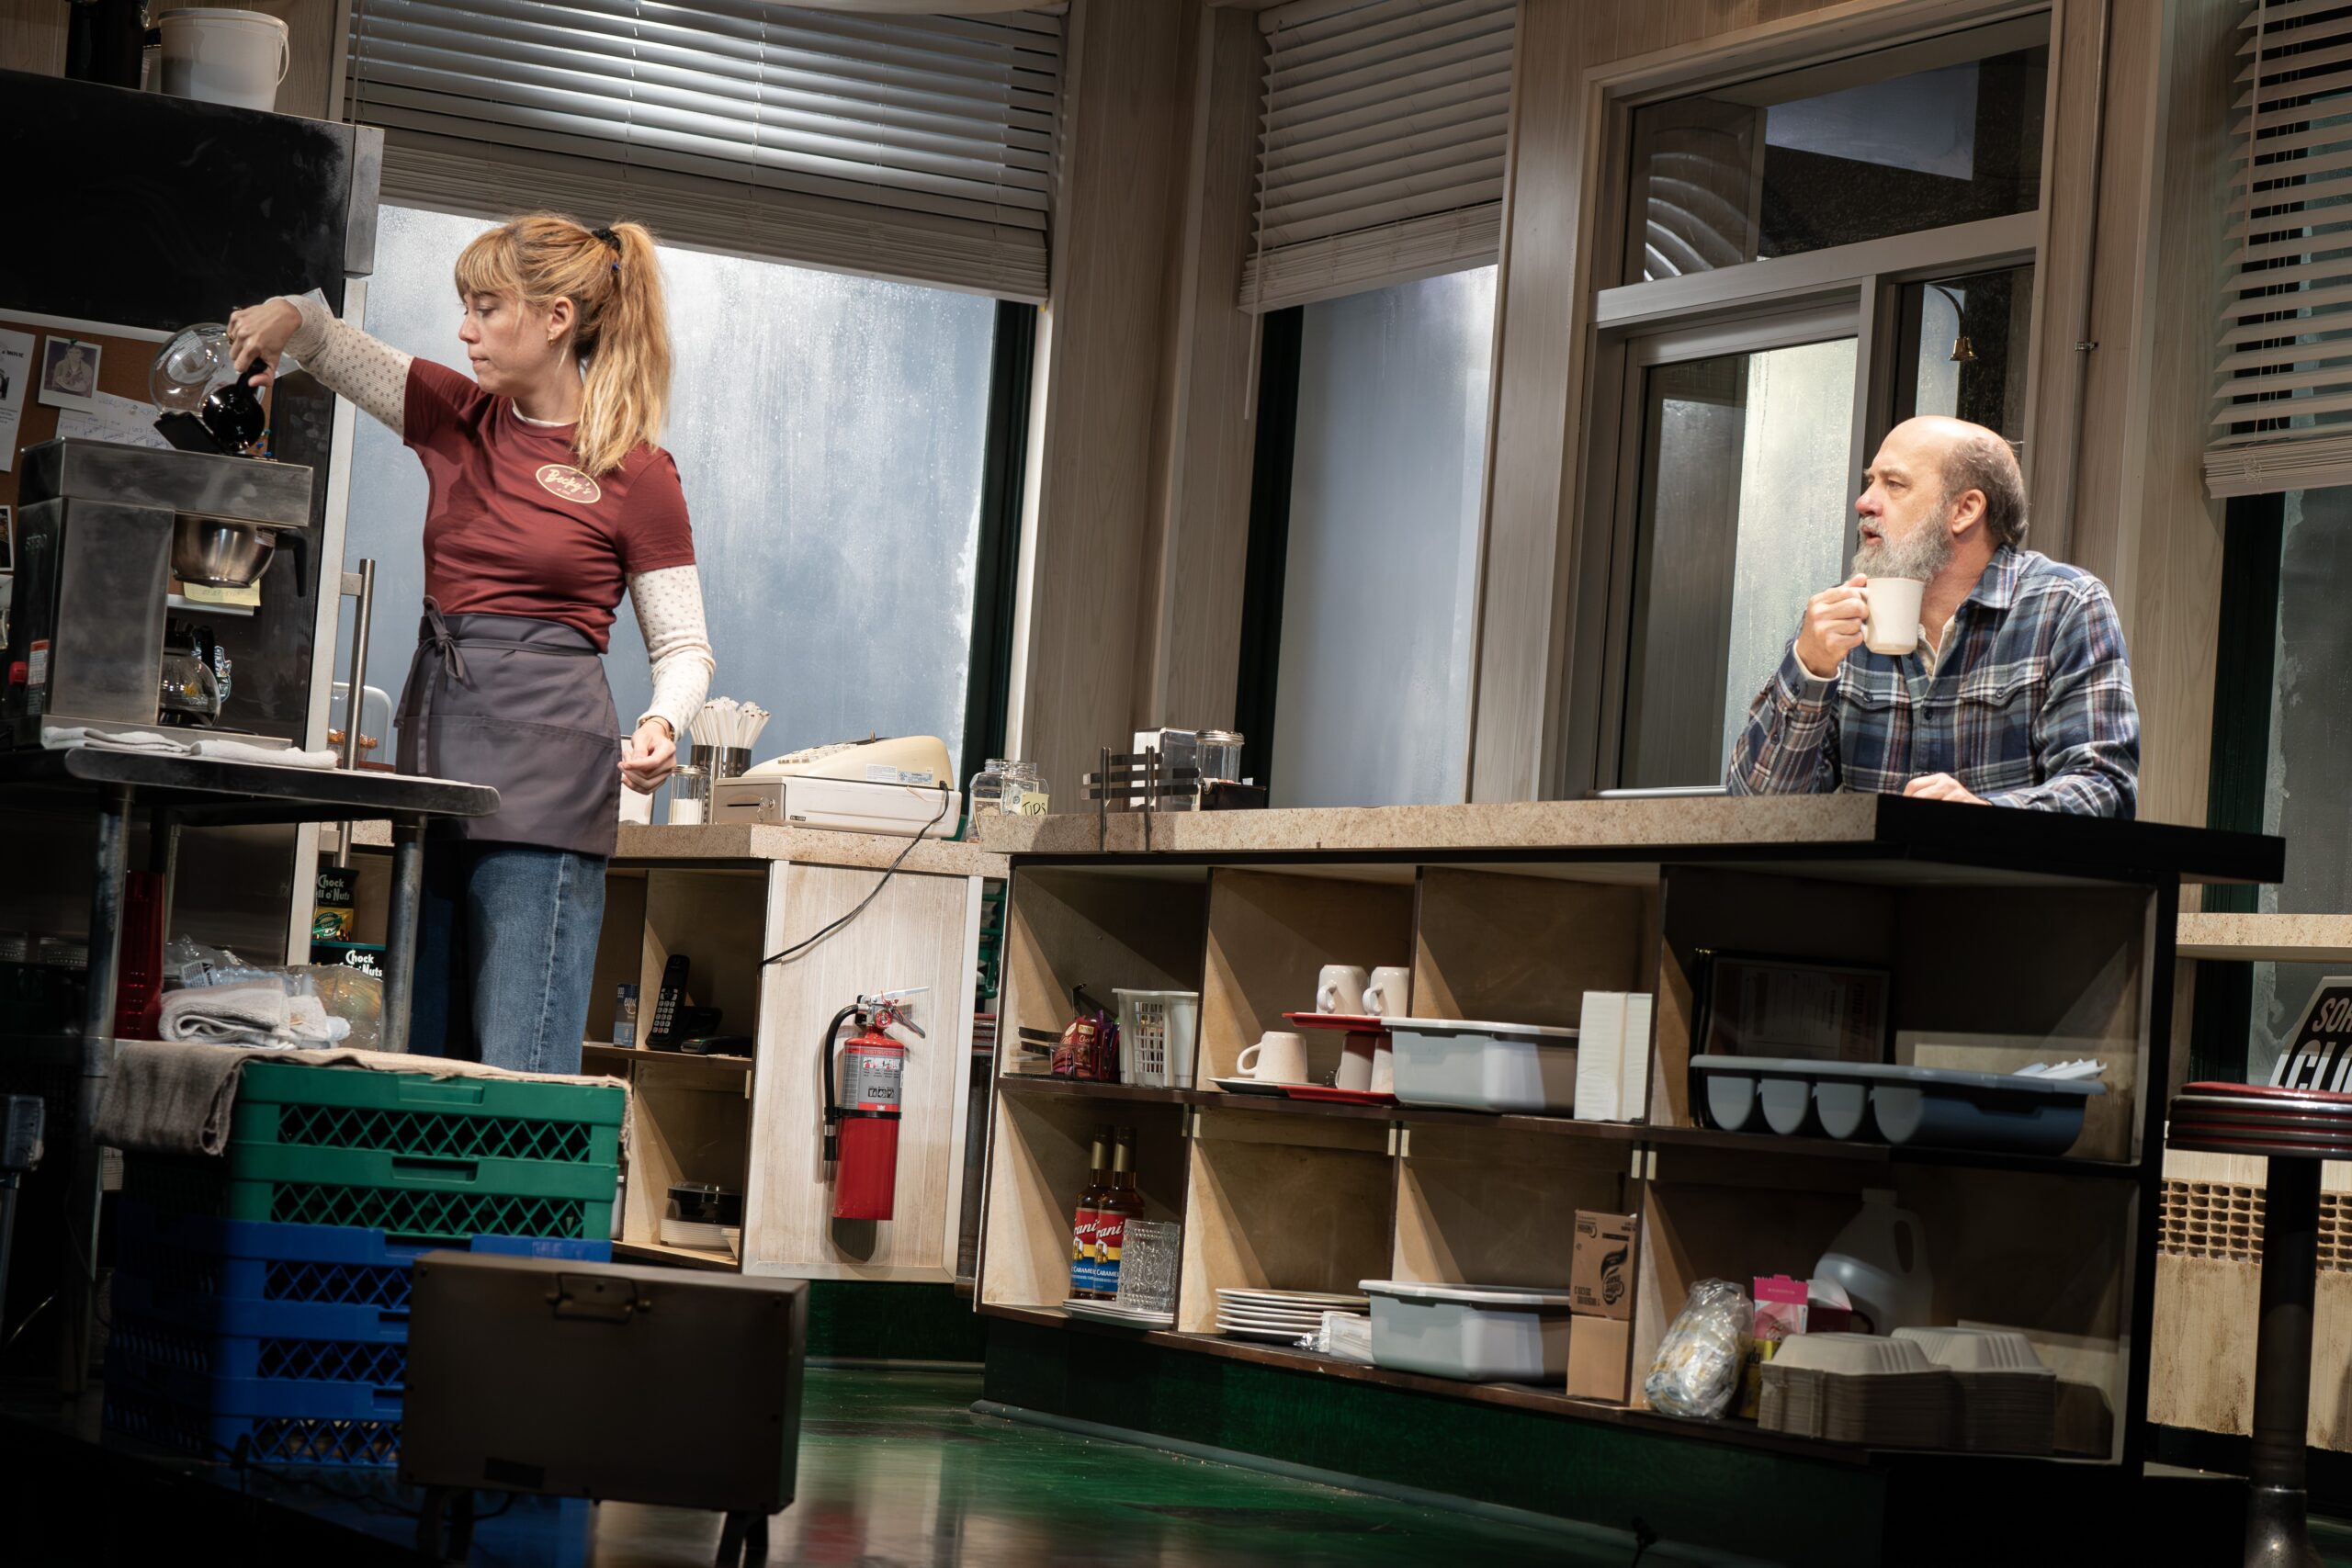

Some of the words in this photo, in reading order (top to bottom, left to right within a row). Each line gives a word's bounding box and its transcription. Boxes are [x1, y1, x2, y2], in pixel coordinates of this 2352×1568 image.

[1022, 801, 1046, 816] TIPS
[318, 874, 345, 889] Chock
[345, 949, 375, 964] Chock
